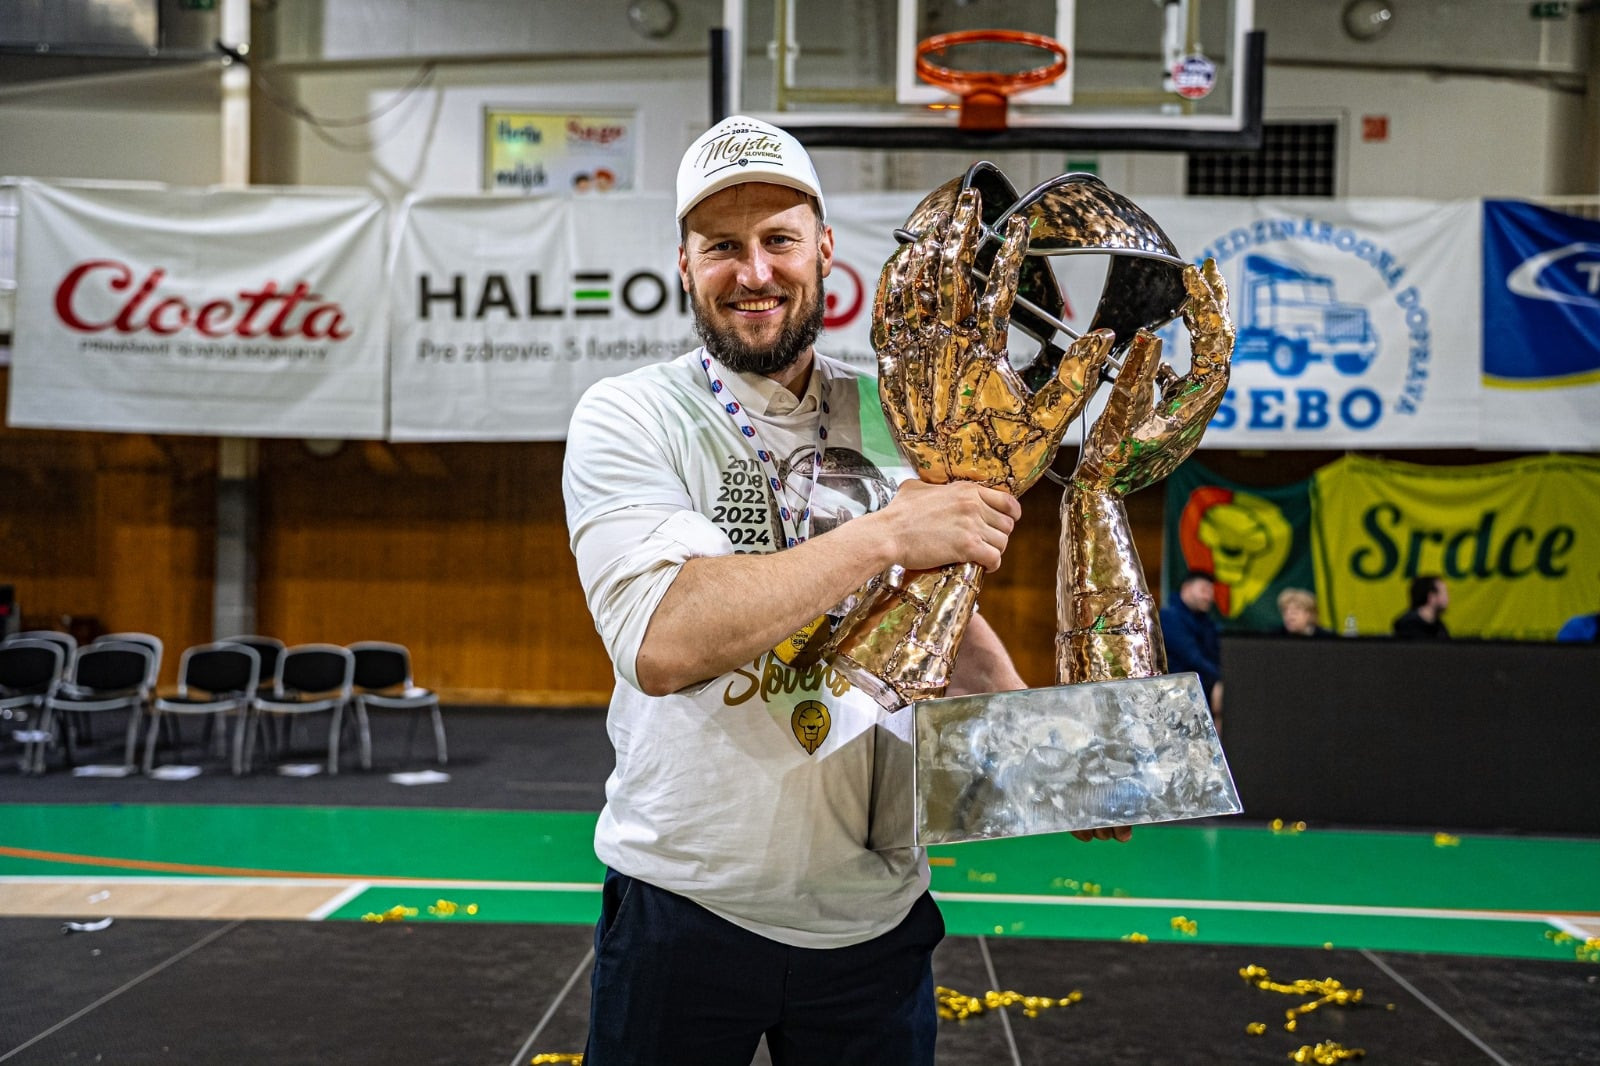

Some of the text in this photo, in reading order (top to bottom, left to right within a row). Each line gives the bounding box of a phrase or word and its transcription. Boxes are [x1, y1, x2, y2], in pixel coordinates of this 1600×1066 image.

[694, 136, 782, 168] Majstri
[744, 151, 782, 160] SLOVENSKA
[54, 260, 353, 341] Cloetta
[418, 273, 689, 320] HALEO
[418, 338, 456, 362] Pre
[563, 338, 582, 362] S
[1208, 387, 1382, 429] SEBO
[722, 471, 763, 488] 2018
[717, 486, 766, 504] 2022
[712, 506, 767, 524] 2023
[720, 527, 770, 545] 024
[1350, 502, 1575, 581] Srdce
